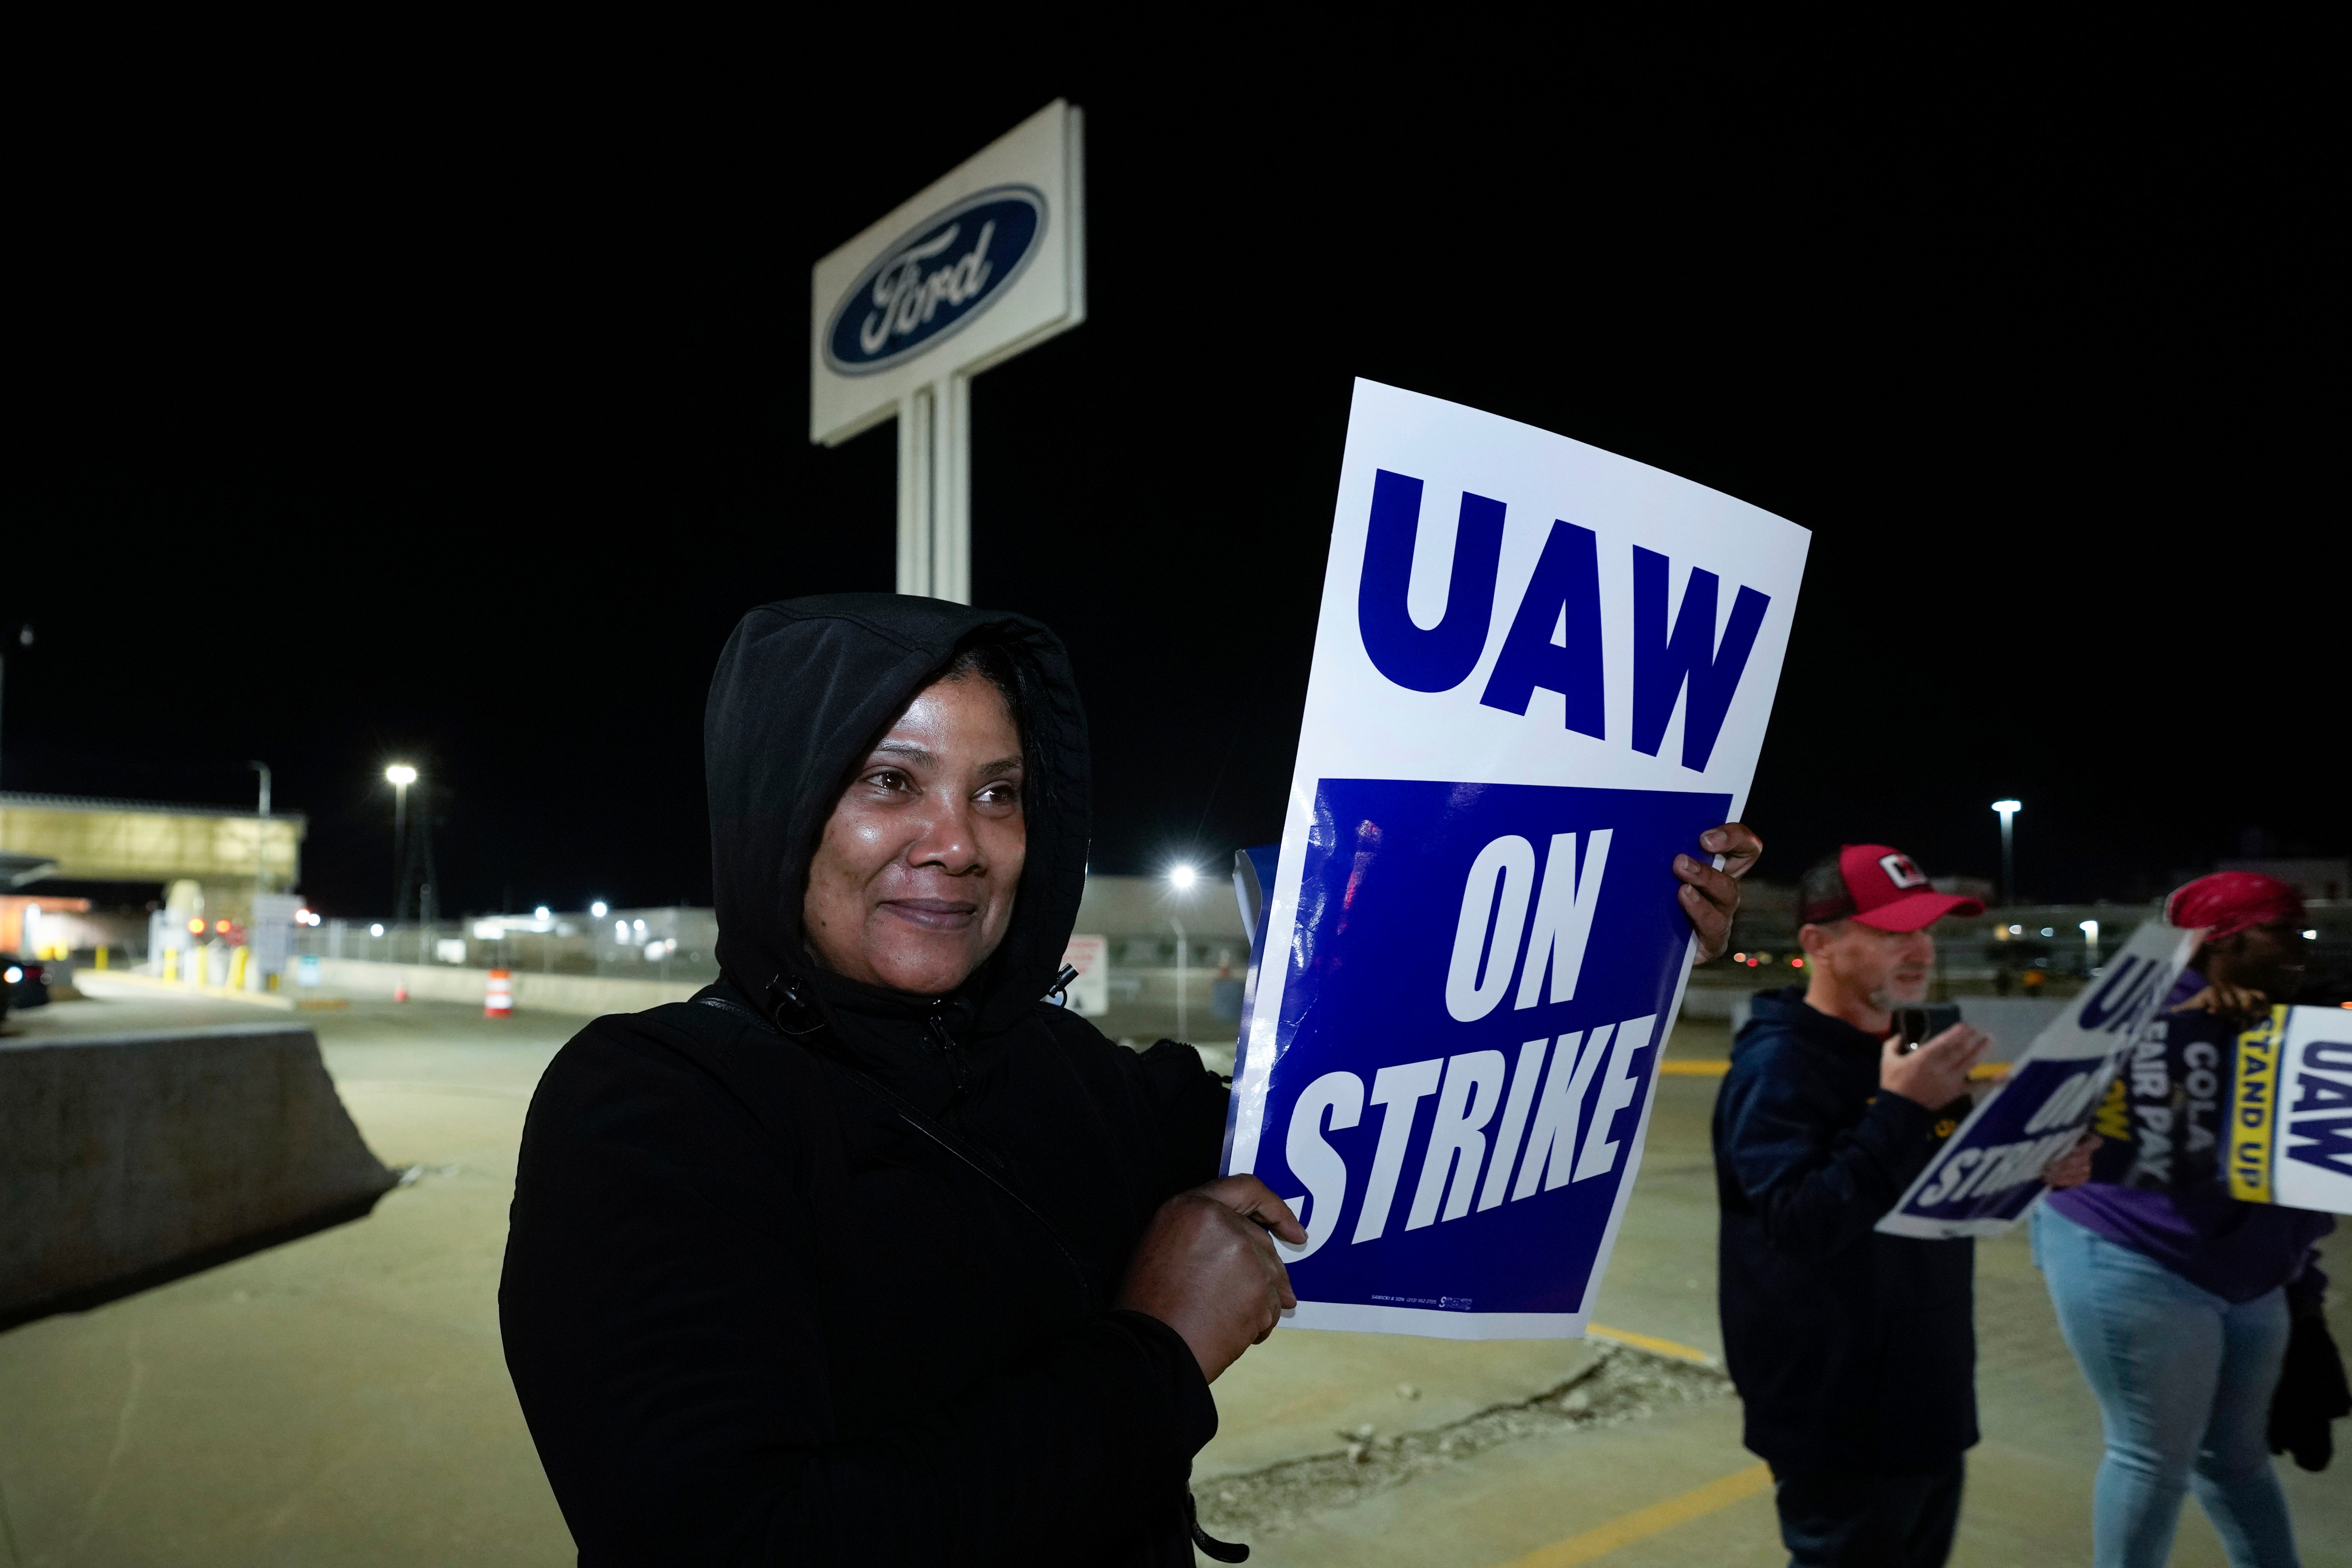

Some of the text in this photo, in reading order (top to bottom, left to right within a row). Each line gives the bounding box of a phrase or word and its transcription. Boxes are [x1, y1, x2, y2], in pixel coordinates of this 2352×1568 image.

[860, 219, 996, 354] Ford
[1358, 469, 1771, 774] UAW
[1445, 828, 1613, 1022] ON
[1268, 1014, 1657, 1264] STRIKE
[2095, 1079, 2131, 1141] OW
[2123, 1020, 2174, 1187] FAIR PAY
[2183, 1041, 2220, 1153] COLA
[2238, 1142, 2262, 1188] UP
[2285, 1040, 2352, 1177] UAW
